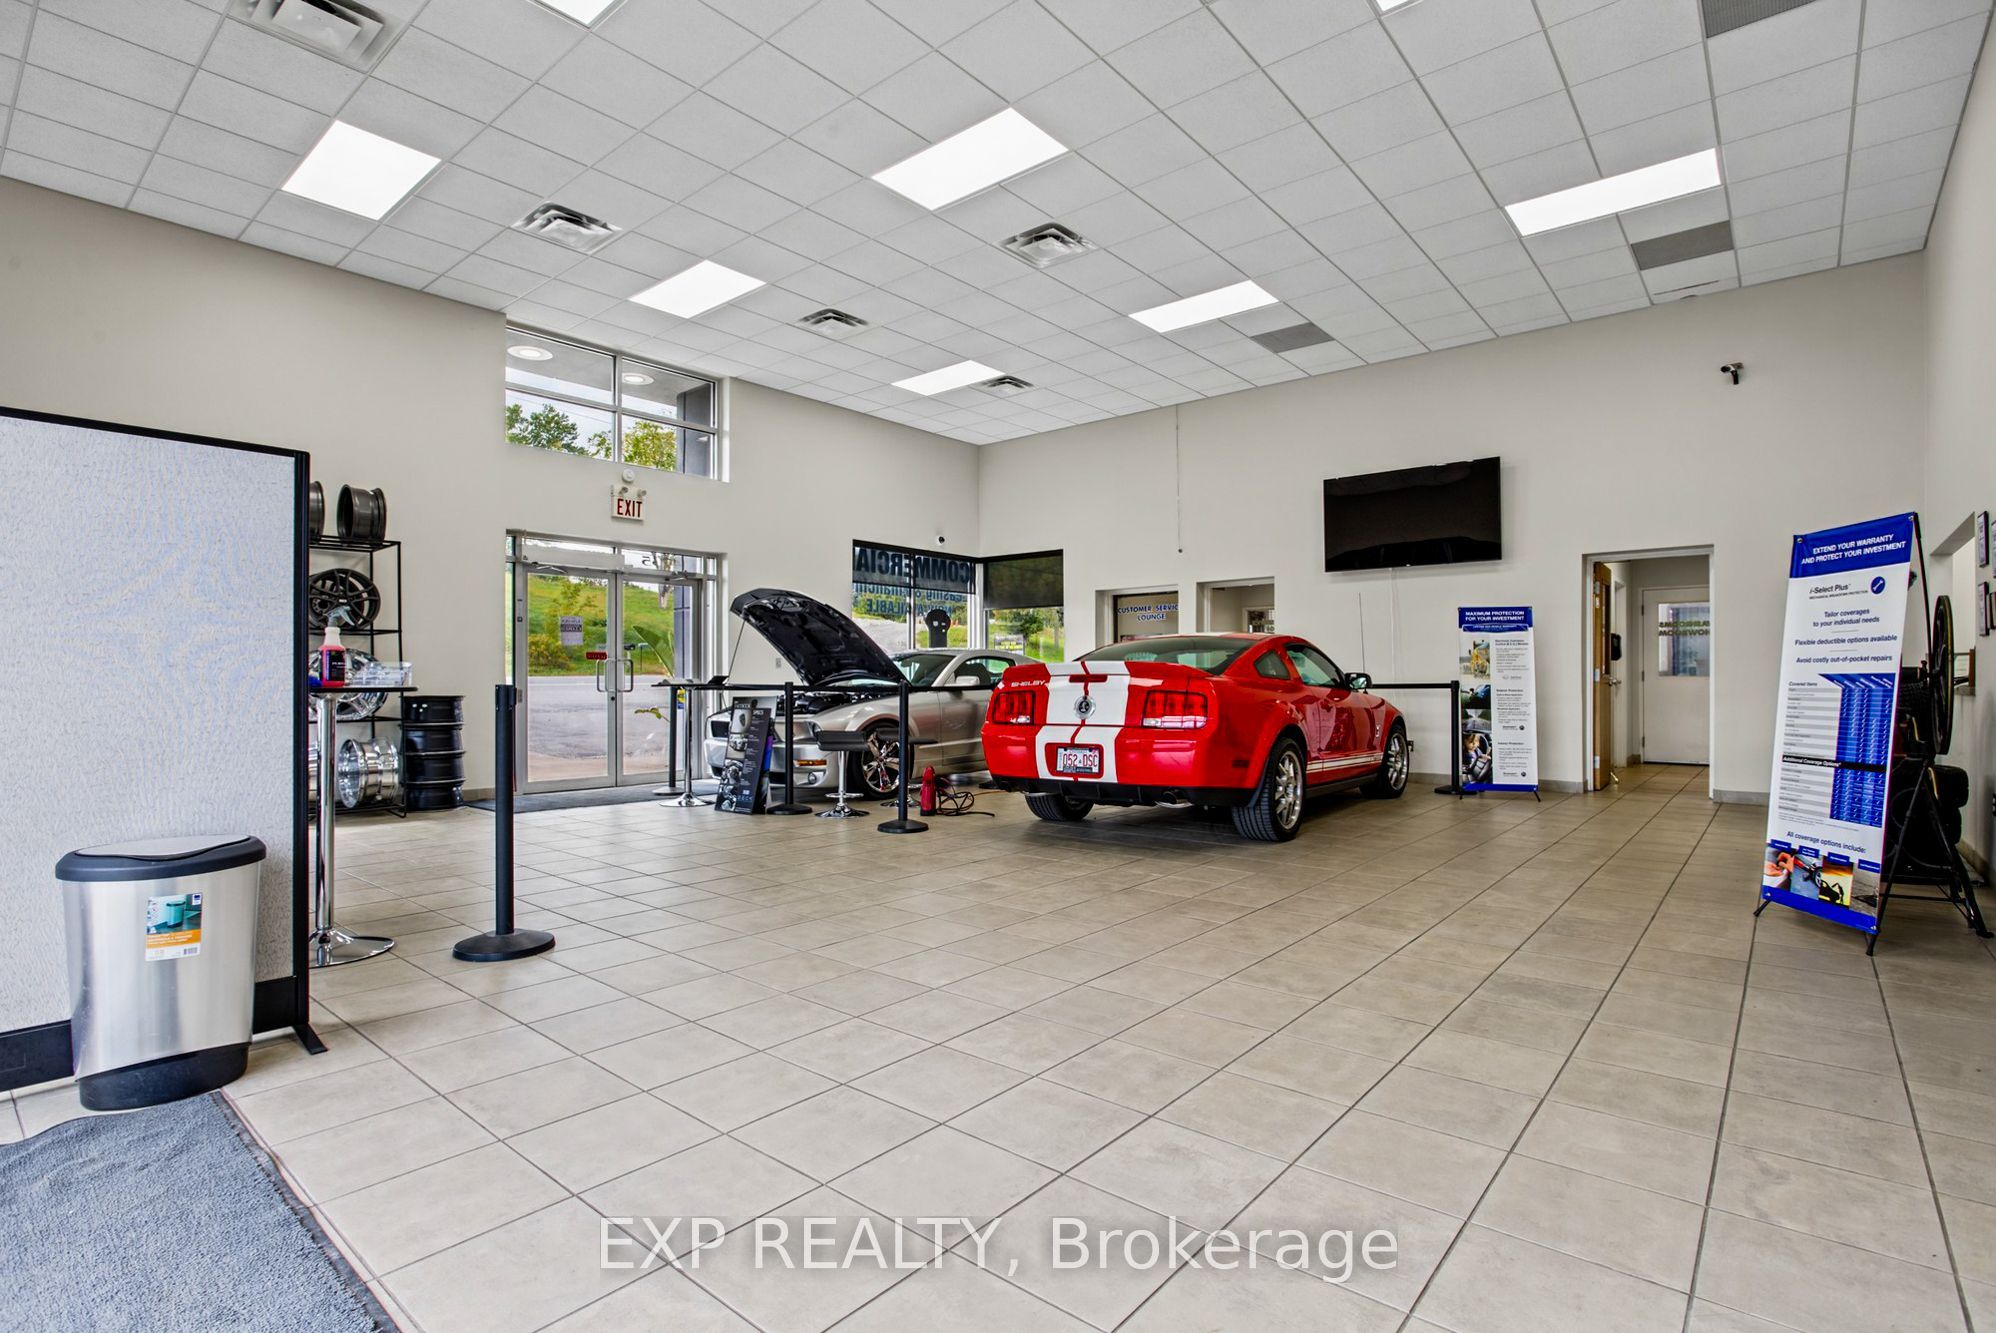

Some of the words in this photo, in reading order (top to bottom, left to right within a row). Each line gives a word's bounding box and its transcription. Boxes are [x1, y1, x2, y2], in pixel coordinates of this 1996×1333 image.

[616, 498, 643, 518] EXIT
[1812, 545, 1837, 555] EXTEND
[1837, 541, 1856, 550] YOUR
[1856, 534, 1894, 547] WARRANTY
[1801, 557, 1815, 565] AND
[1815, 552, 1843, 562] PROTECT
[1844, 549, 1862, 558] YOUR
[1862, 541, 1907, 555] INVESTMENT
[1809, 585, 1833, 594] i-Select
[1117, 605, 1152, 614] CUSTOMER
[1840, 608, 1870, 617] coverages
[1137, 613, 1165, 621] LOUNGE
[1820, 620, 1833, 628] your
[1834, 617, 1861, 626] individual
[1816, 637, 1846, 645] deductible
[1847, 636, 1869, 644] options
[1870, 634, 1898, 643] available
[1812, 656, 1829, 664] costly
[1830, 655, 1870, 663] out-of-pocket
[1870, 654, 1893, 663] repairs
[1011, 680, 1046, 688] SHELBY
[1083, 754, 1098, 767] DSC
[1794, 833, 1820, 844] coverage
[1820, 839, 1842, 849] options
